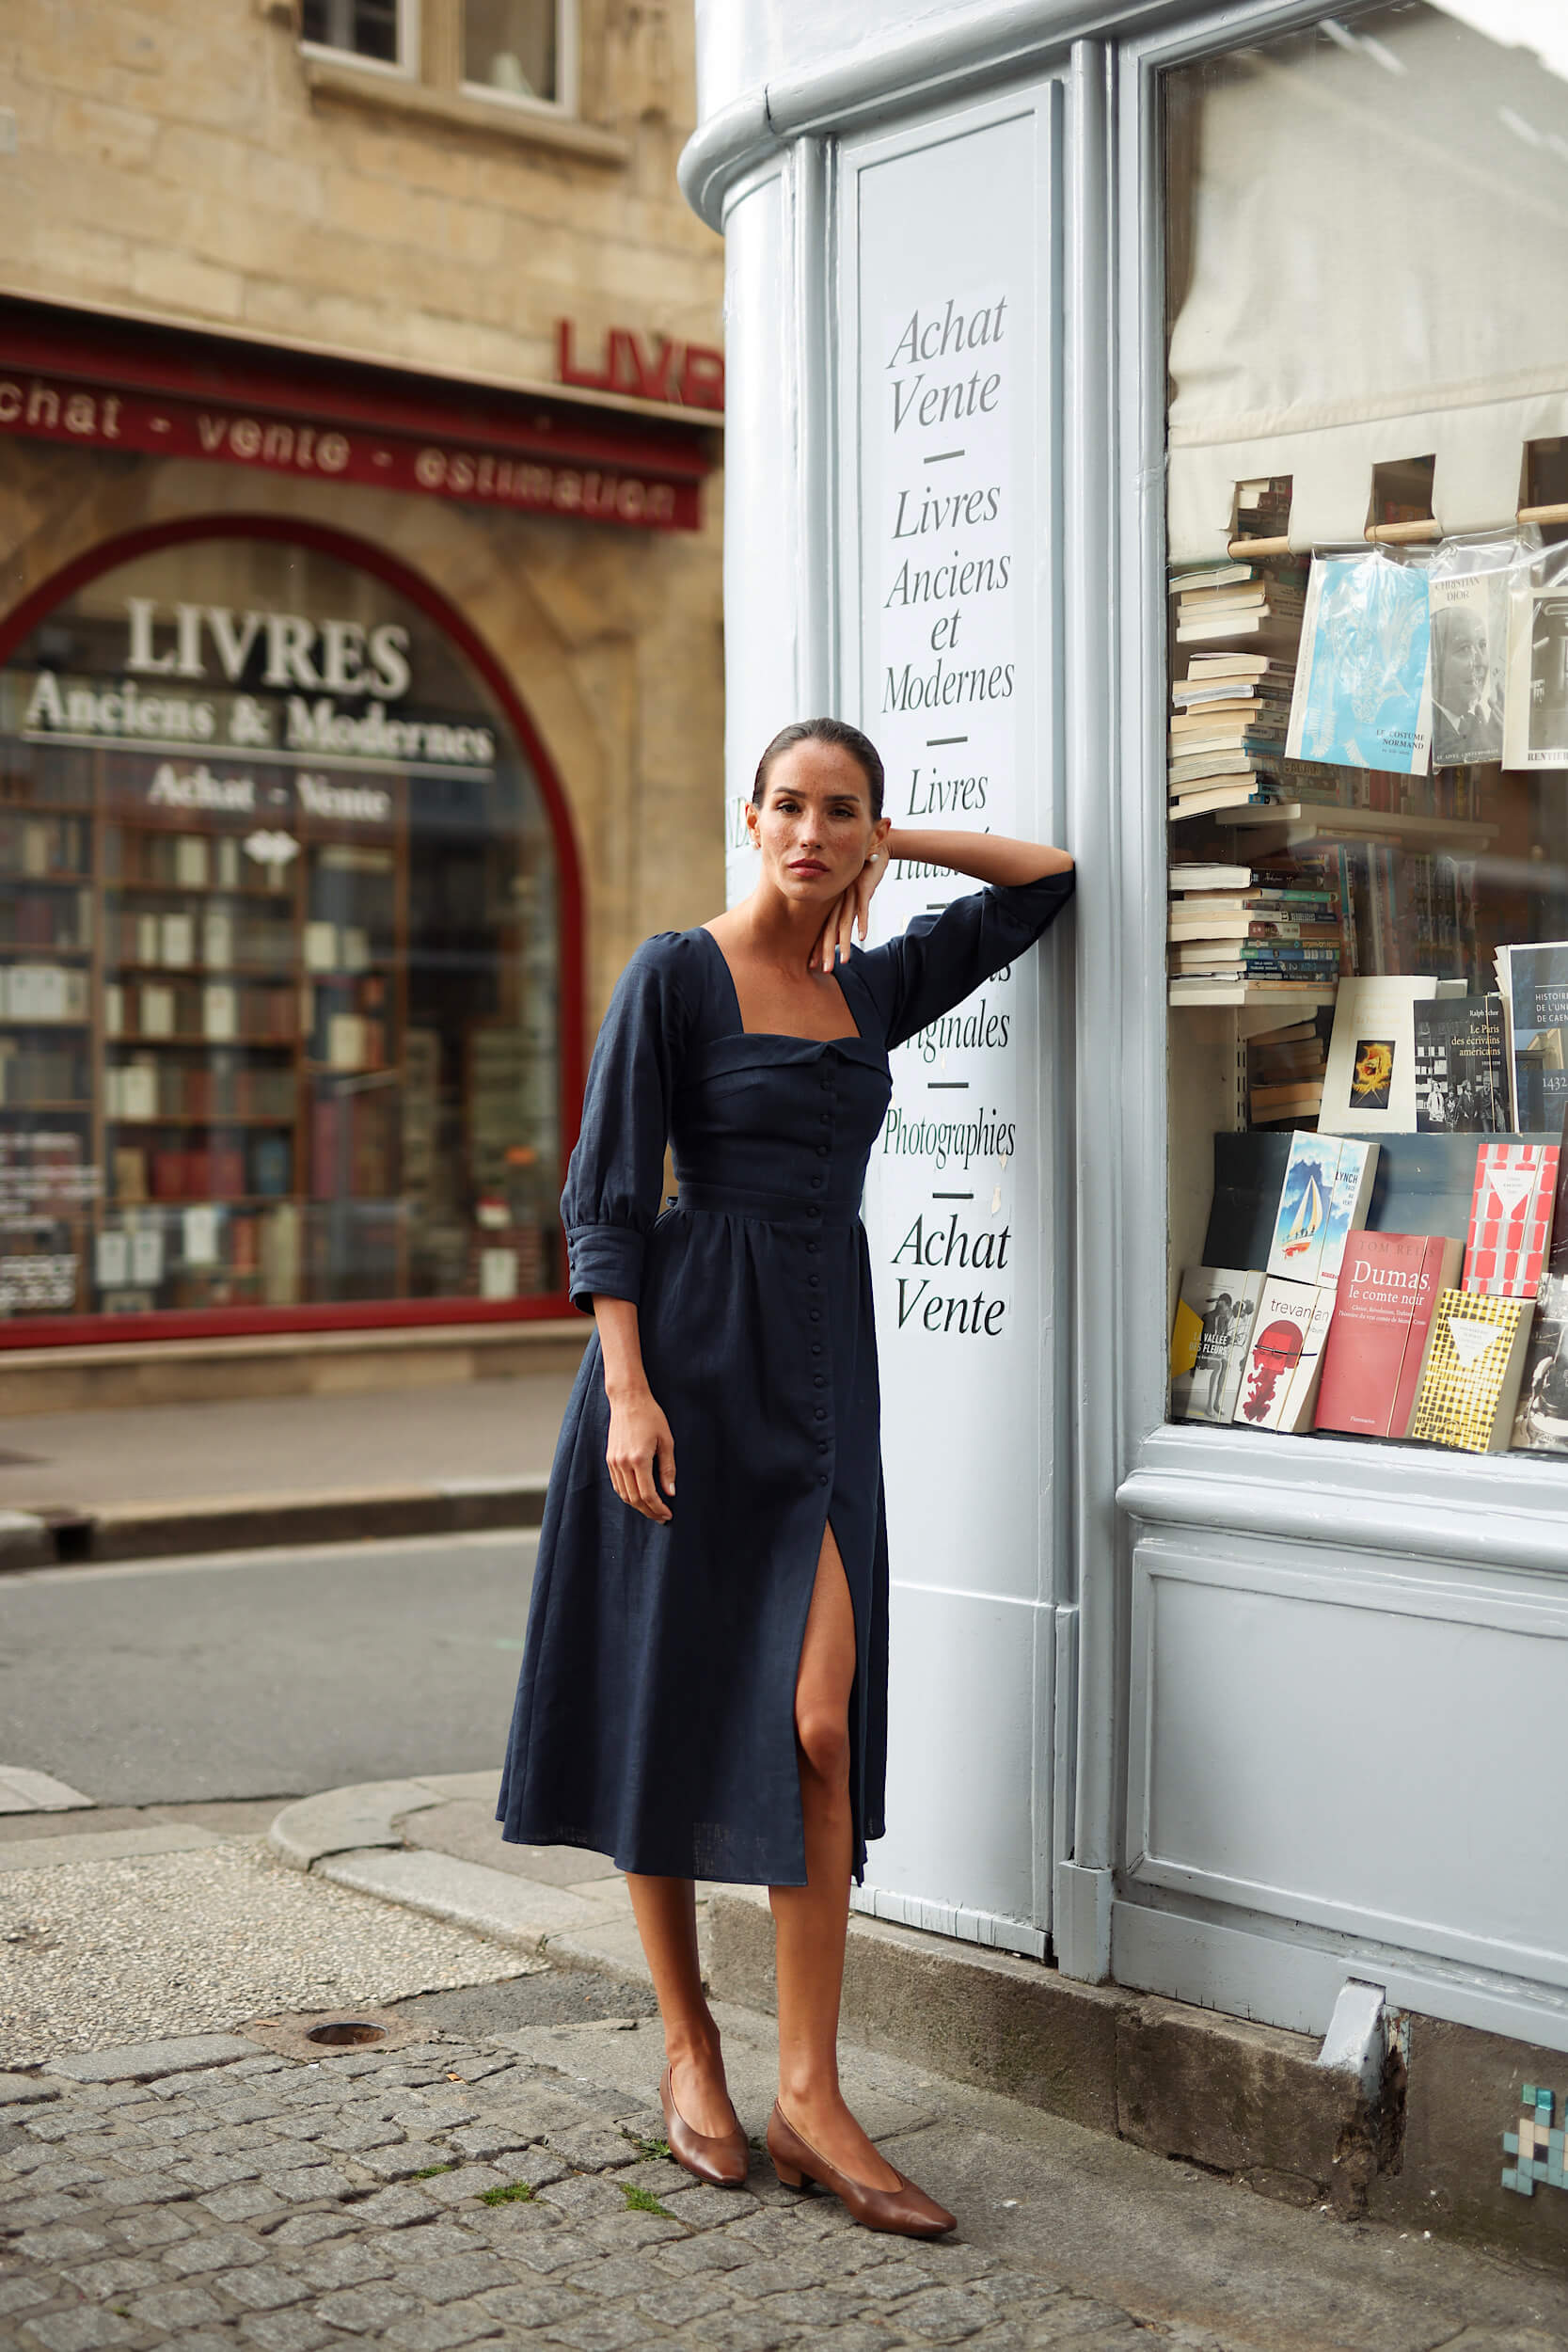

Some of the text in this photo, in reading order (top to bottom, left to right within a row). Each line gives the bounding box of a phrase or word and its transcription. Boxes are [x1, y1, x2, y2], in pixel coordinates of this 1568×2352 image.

[886, 295, 1006, 369] Achat
[891, 370, 1001, 434] Vente
[197, 413, 350, 472] vente
[415, 448, 675, 520] estimation
[891, 485, 1001, 539] Livres
[883, 549, 1011, 608] Anciens
[1435, 577, 1480, 591] CHRISTIAN
[1447, 592, 1469, 602] DIOR
[126, 596, 411, 700] LIVRES
[930, 609, 961, 651] et
[881, 657, 1015, 713] Modernes
[24, 671, 495, 763] Anciens & Modernes
[1389, 731, 1424, 741] COSTUME
[1384, 739, 1424, 750] NORMAND
[148, 764, 256, 812] Achat
[296, 774, 390, 821] Vente
[906, 768, 989, 816] Livres
[906, 998, 1010, 1063] iginales
[1451, 1035, 1465, 1045] des
[1470, 1025, 1481, 1034] Le
[1537, 1014, 1546, 1023] DE
[880, 1106, 1016, 1170] Photographies
[1336, 1170, 1358, 1184] LYNCH
[890, 1214, 1011, 1269] Achat
[895, 1278, 1006, 1336] Vente
[1349, 1284, 1425, 1306] le comte noir
